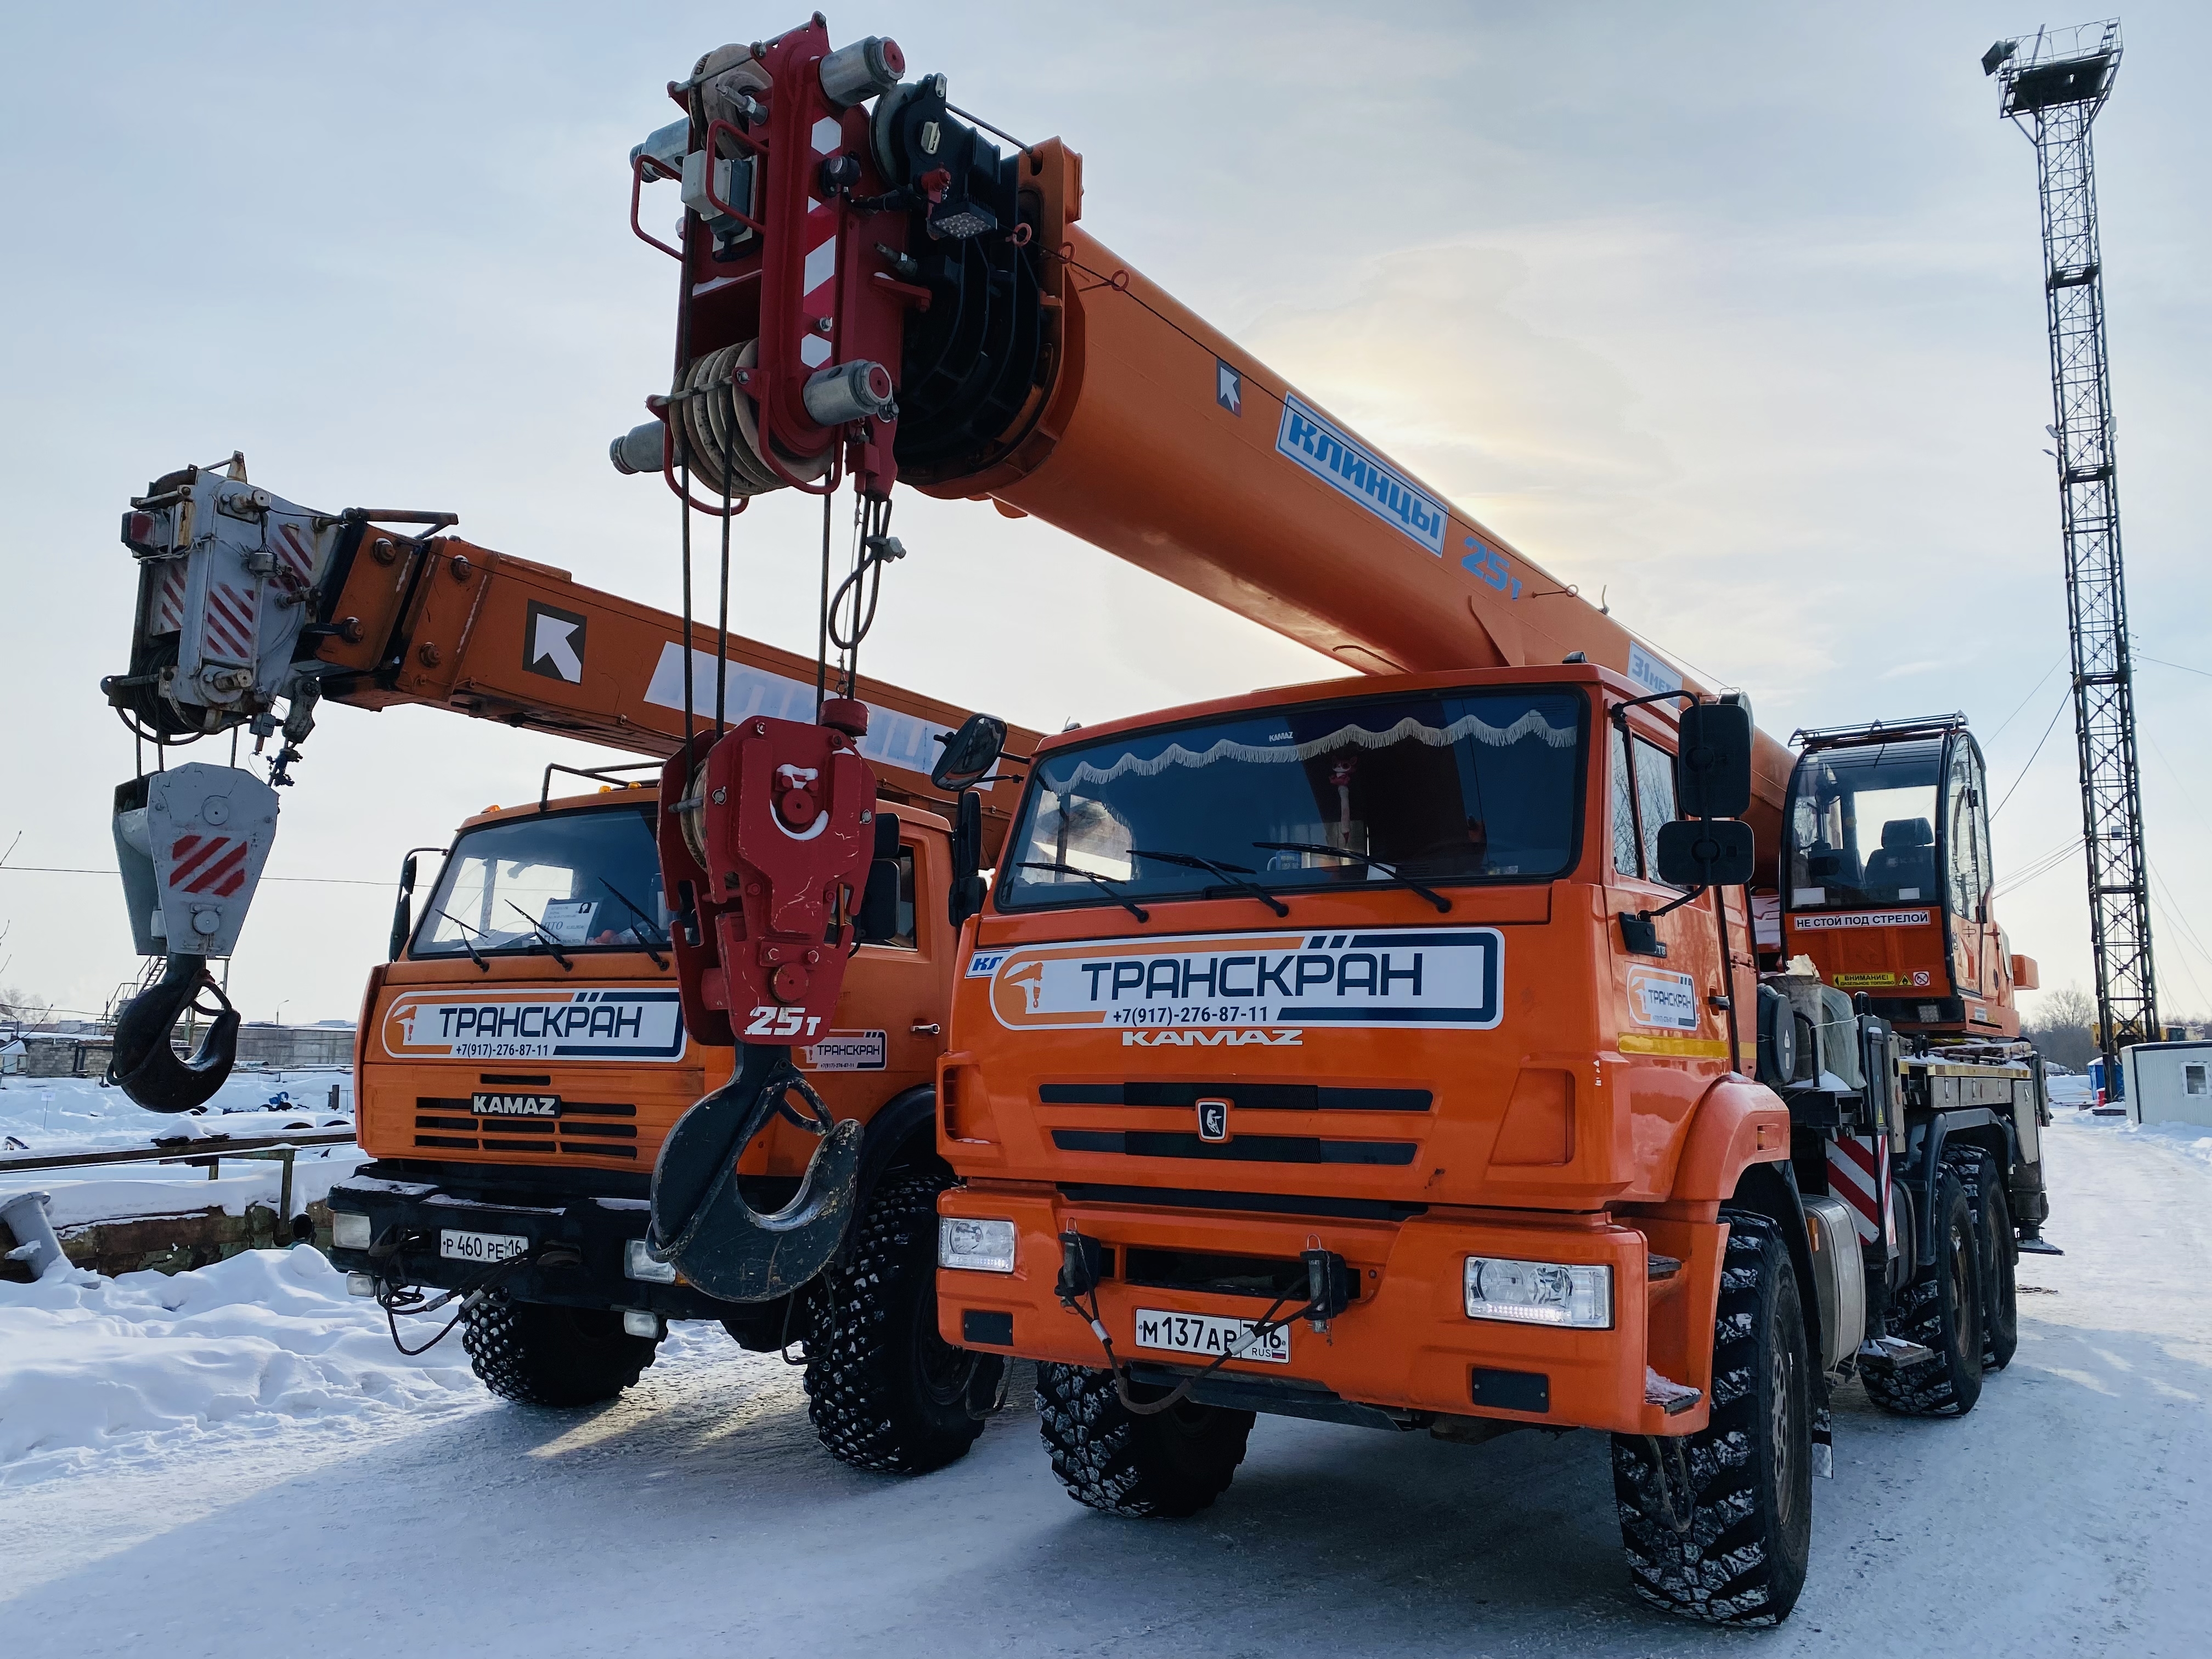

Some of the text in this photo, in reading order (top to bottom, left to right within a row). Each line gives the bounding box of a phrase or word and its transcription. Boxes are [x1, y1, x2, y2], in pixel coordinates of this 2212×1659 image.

[1288, 413, 1441, 540] КЛИНЦЫ
[1268, 731, 1294, 742] KAMAZ
[1797, 911, 1928, 928] НЕ СТОЙ ПОД СТРЕЛОЙ
[1081, 952, 1423, 1001] ТРАНСКРАН
[1648, 989, 1692, 1009] ТРАНСКРАН
[439, 1006, 643, 1038] ТРАНСКРАН
[1113, 1006, 1268, 1027] +7(917)-276-87-11
[1122, 1029, 1304, 1046] KAMAZ
[456, 1043, 549, 1058] +7(917)-276-87-11
[817, 1045, 880, 1056] ТРАНСКРАН
[473, 1096, 555, 1115] KAMAZ
[1252, 1347, 1271, 1357] RUS
